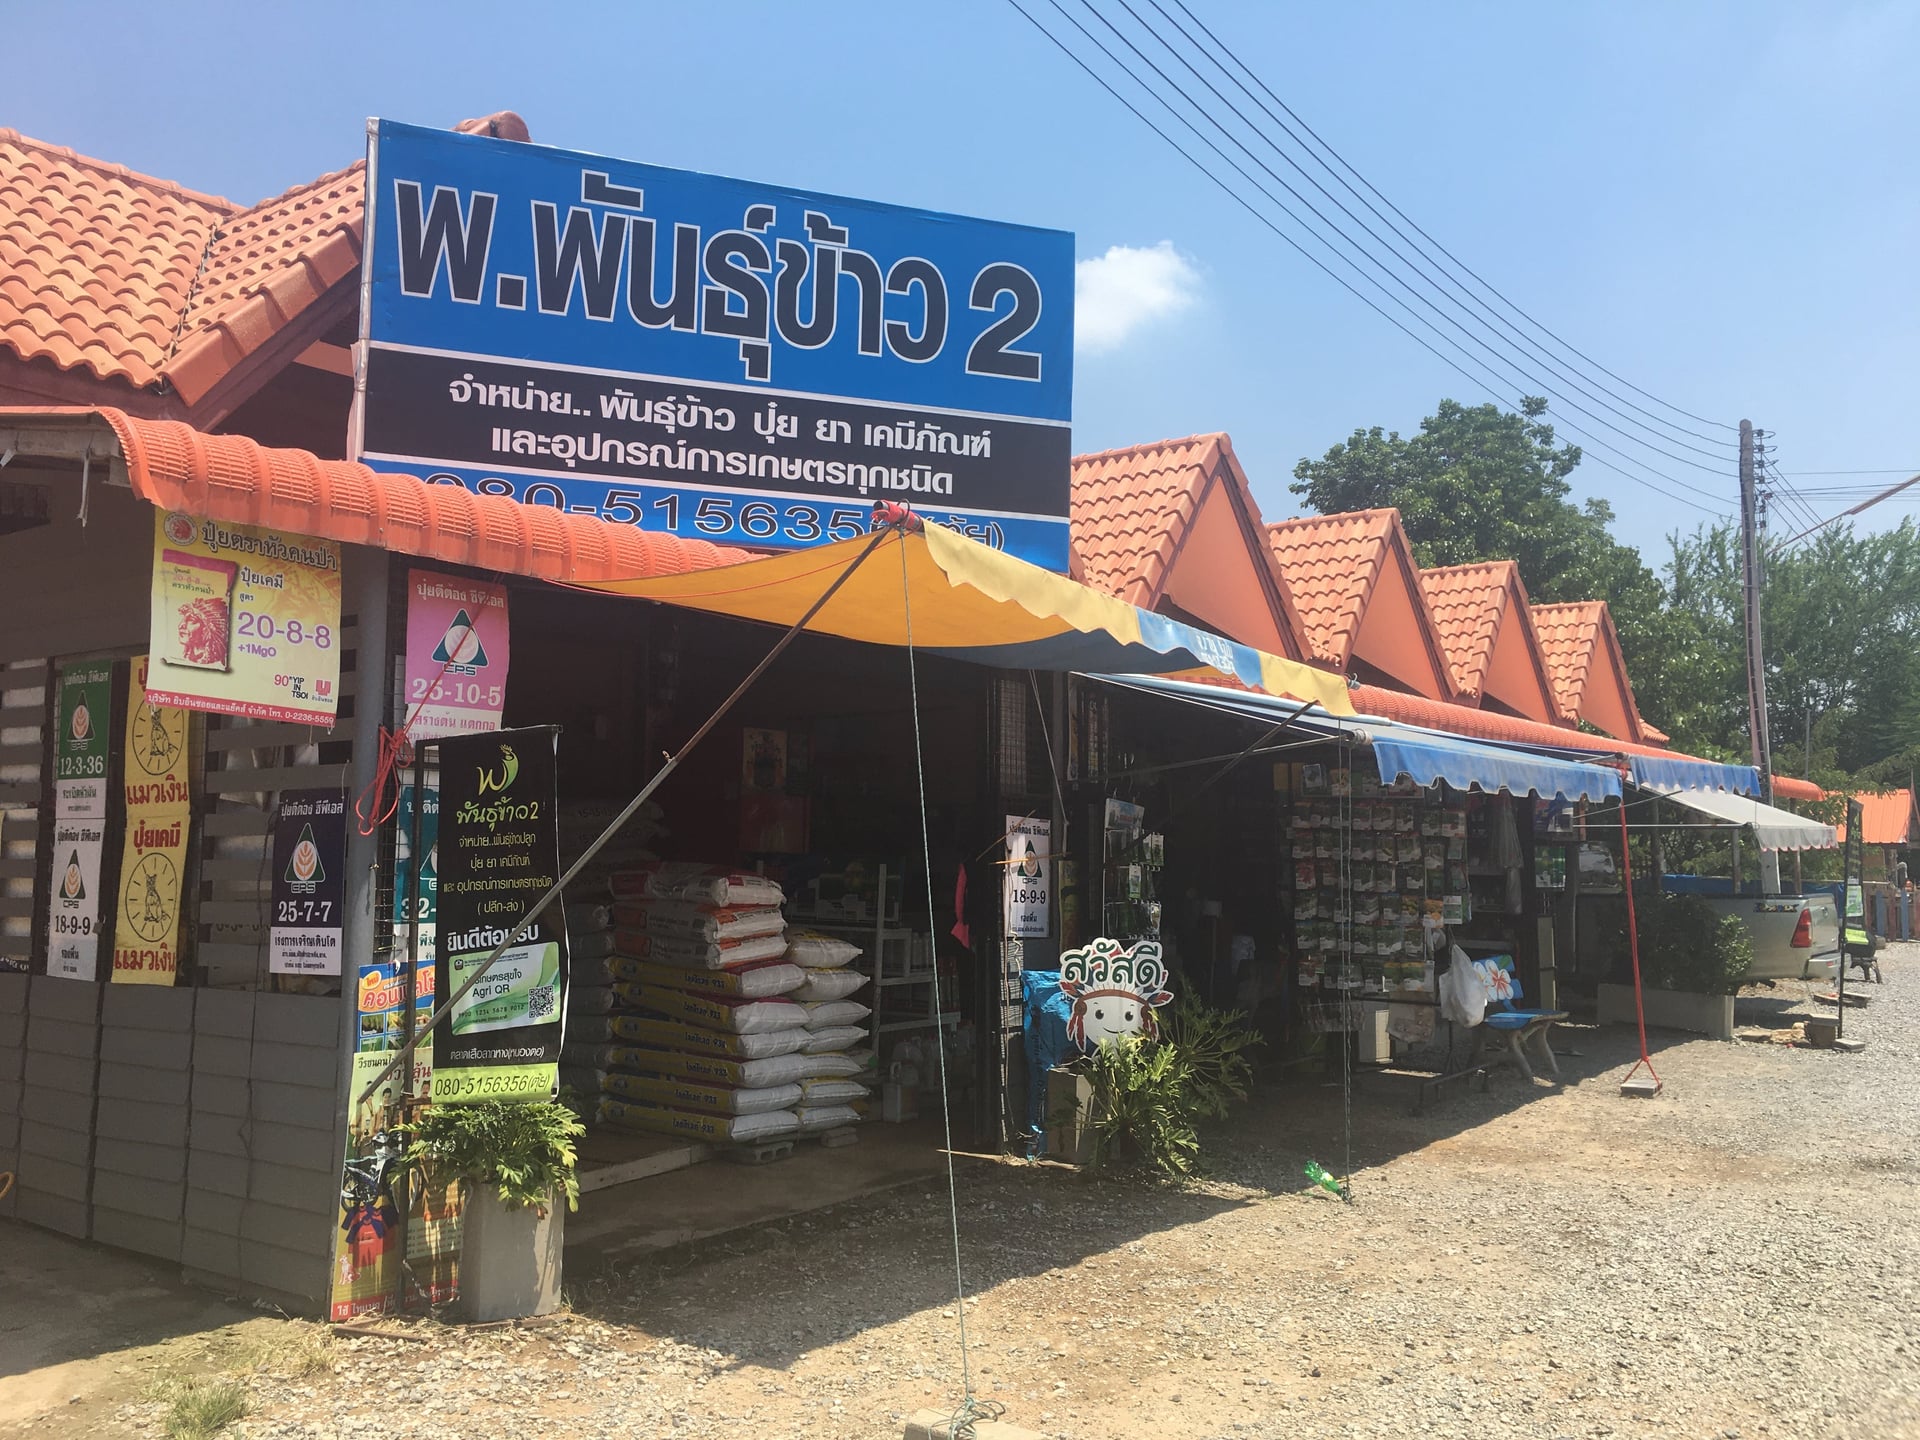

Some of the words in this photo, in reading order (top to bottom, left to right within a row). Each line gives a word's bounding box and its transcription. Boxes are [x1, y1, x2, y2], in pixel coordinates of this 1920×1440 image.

[965, 261, 1043, 382] 2
[600, 388, 736, 434] พันธุ์ข้าว
[754, 401, 798, 444] ปุ๋ย
[815, 418, 851, 444] ยา
[864, 420, 991, 458] เคมีภัณฑ์
[492, 427, 953, 495] และอุปกรณ์การเกษตรทุกชนิด
[202, 520, 338, 572] ปุ๋ยตราหัวคนป่า
[240, 566, 283, 589] ปุ๋ยเคมี
[238, 611, 331, 649] 20-8-8
[238, 644, 276, 658] +1MgO
[293, 676, 304, 685] YIP
[294, 683, 301, 691] IN
[291, 690, 308, 699] TSOI
[412, 678, 501, 707] 25-10-5
[460, 718, 496, 731] แตกกอ
[60, 755, 103, 776] 12-3-36
[126, 774, 188, 805] แมวเงิน
[133, 819, 181, 855] ปุ๋ยเคมี
[487, 858, 496, 868] ยา
[1013, 889, 1046, 904] 18-9-9
[278, 900, 332, 923] 25-7-7
[55, 915, 91, 935] 18-9-9
[275, 931, 336, 948] เร่งการเจริญเติบโต
[114, 942, 176, 973] แมวเงิน
[1064, 941, 1161, 987] สวัสดี
[472, 986, 492, 998] Agri
[495, 984, 510, 994] QR
